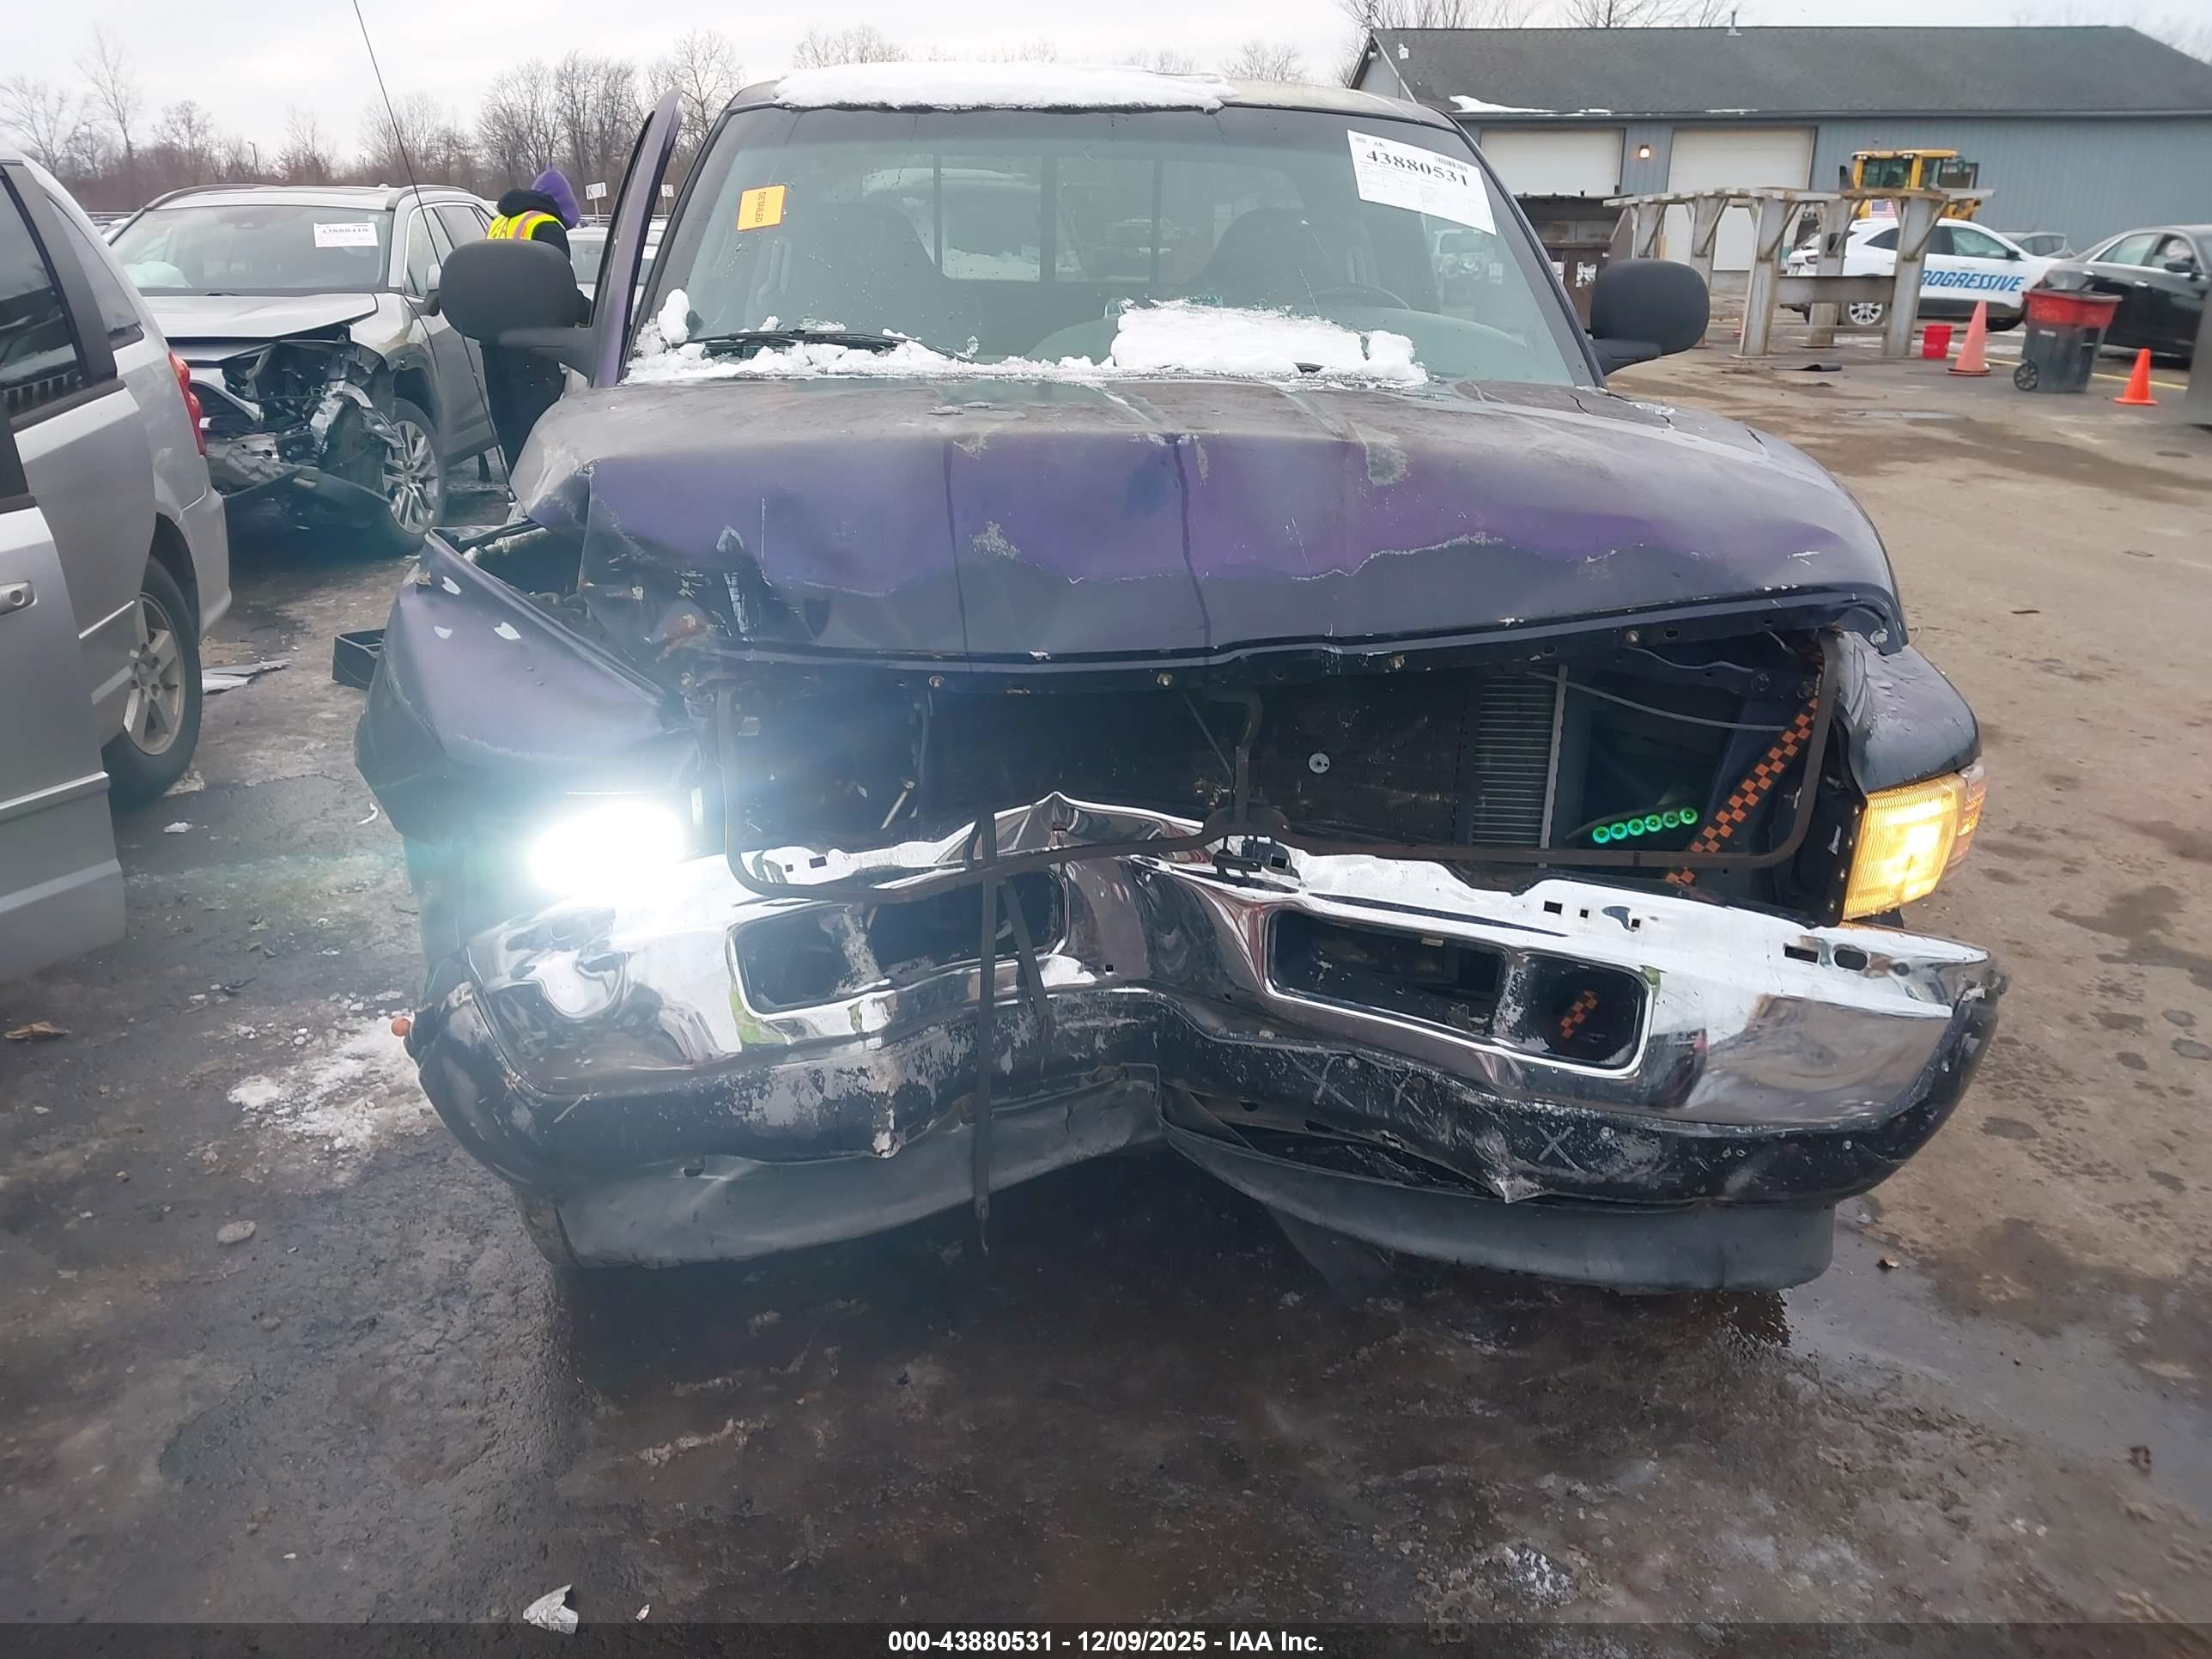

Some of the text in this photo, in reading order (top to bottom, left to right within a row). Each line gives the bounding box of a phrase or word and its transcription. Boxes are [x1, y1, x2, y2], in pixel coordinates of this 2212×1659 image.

[1365, 149, 1470, 187] 43880531
[755, 191, 767, 223] DETAILED
[1922, 270, 2026, 292] ROGRESSIVE
